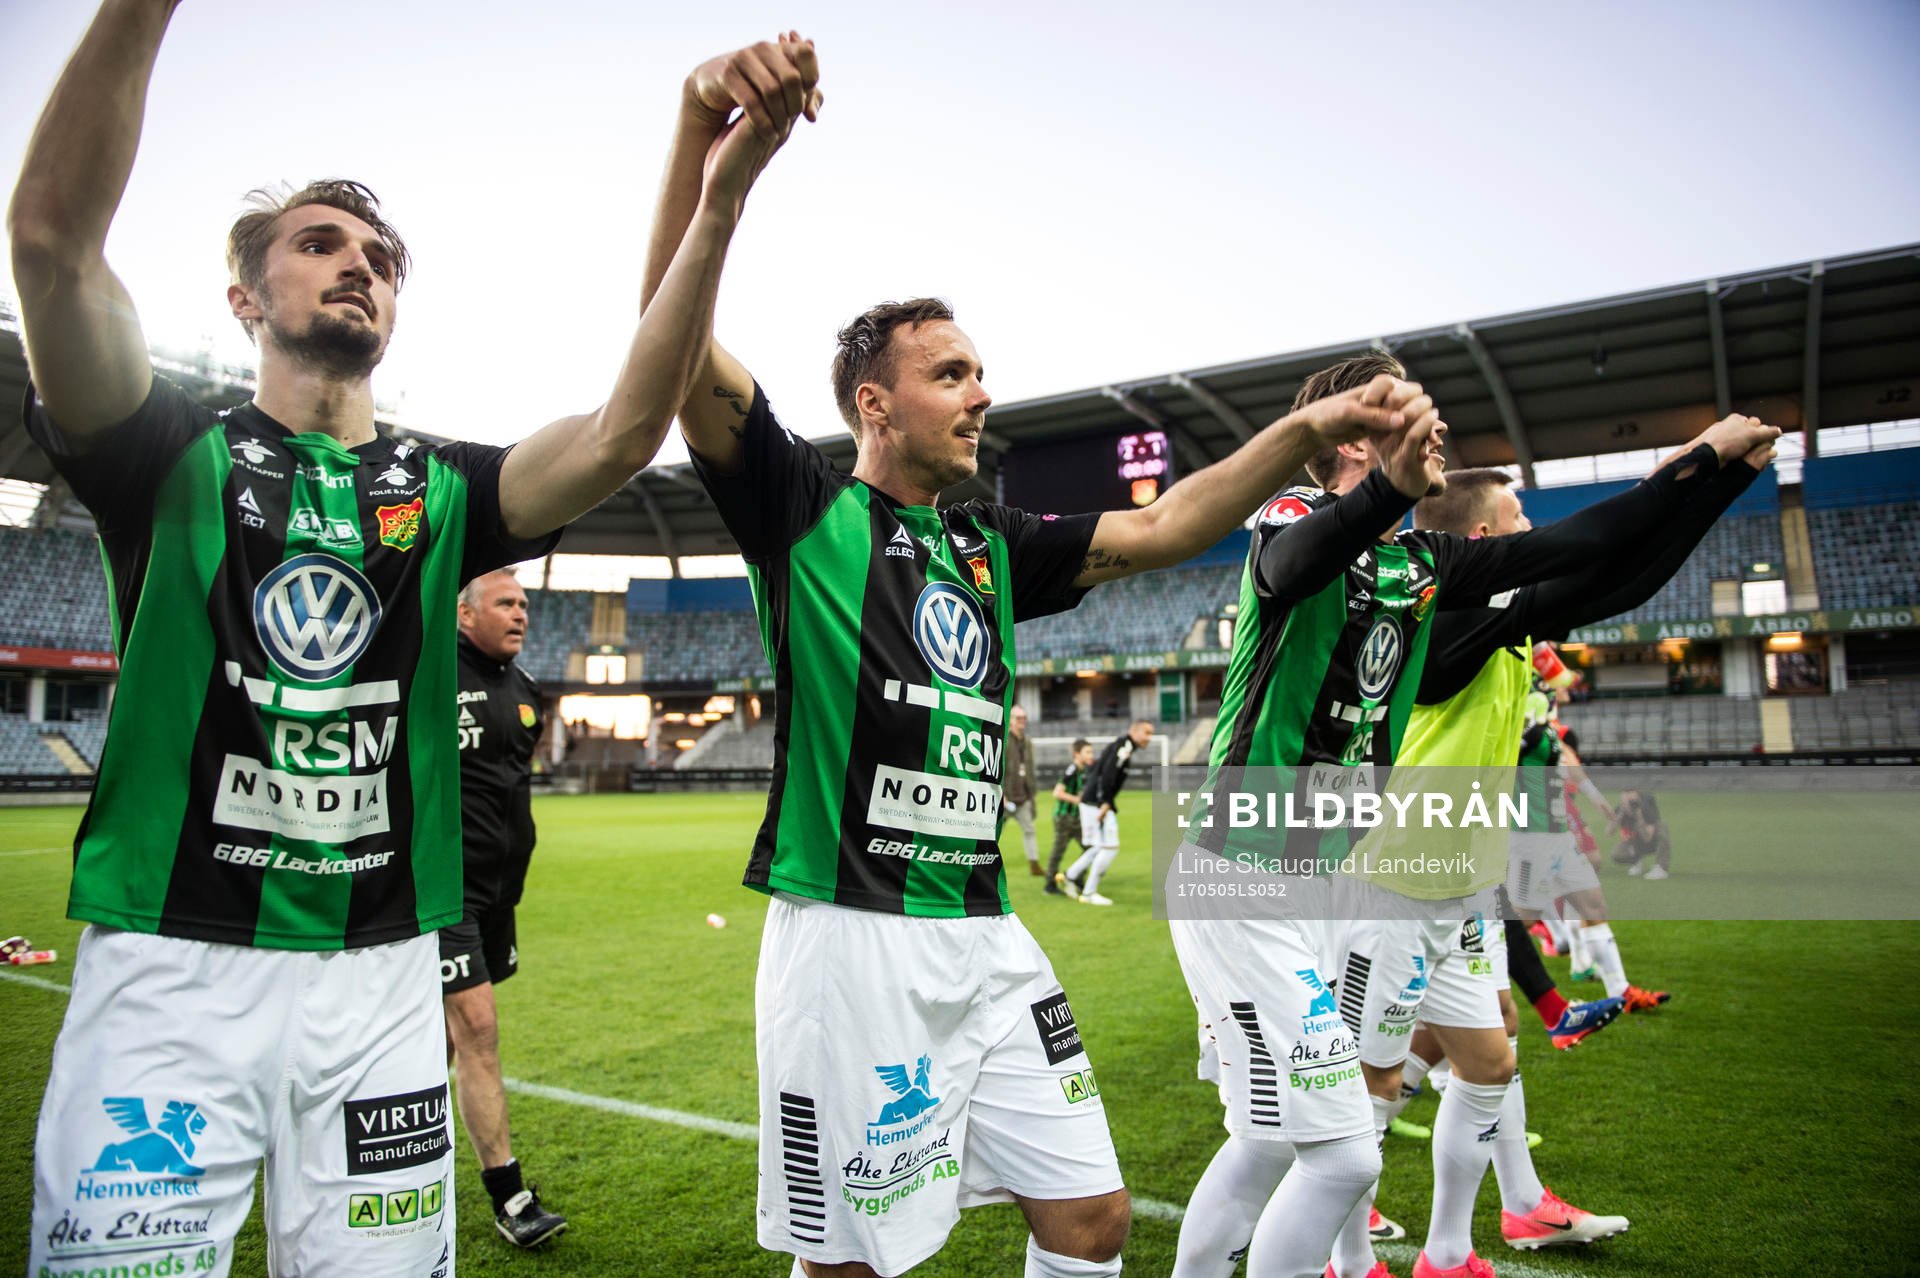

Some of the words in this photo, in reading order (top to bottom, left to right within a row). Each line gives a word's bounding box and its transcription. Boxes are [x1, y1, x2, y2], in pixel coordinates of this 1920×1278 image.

[253, 466, 285, 480] PAPPER
[369, 488, 393, 497] FOLIE
[885, 546, 916, 560] SELECT
[264, 565, 371, 670] VW
[920, 590, 983, 680] VW
[1358, 621, 1399, 694] VW
[274, 716, 399, 769] RSM
[939, 724, 1002, 779] RSM
[231, 769, 379, 812] NORDIA
[881, 777, 997, 815] NORDIA
[227, 803, 264, 817] SWEDEN
[879, 807, 908, 818] SWEDEN
[912, 813, 941, 824] NORWAY
[213, 843, 273, 868] GBG
[271, 850, 395, 875] Lackcenter
[867, 837, 917, 860] GBG
[917, 845, 999, 866] Lackcenter
[1289, 1040, 1320, 1064] Åke
[357, 1098, 447, 1134] VIRTUA
[866, 1108, 938, 1147] Hemverket
[842, 1151, 882, 1179] Åke
[889, 1128, 951, 1175] Ekstrand
[75, 1178, 201, 1201] Hemverket
[841, 1171, 926, 1217] Byggnads
[932, 1159, 961, 1182] AB
[48, 1208, 92, 1249] Åke
[106, 1208, 214, 1240] Ekstrand
[194, 1247, 217, 1271] AB
